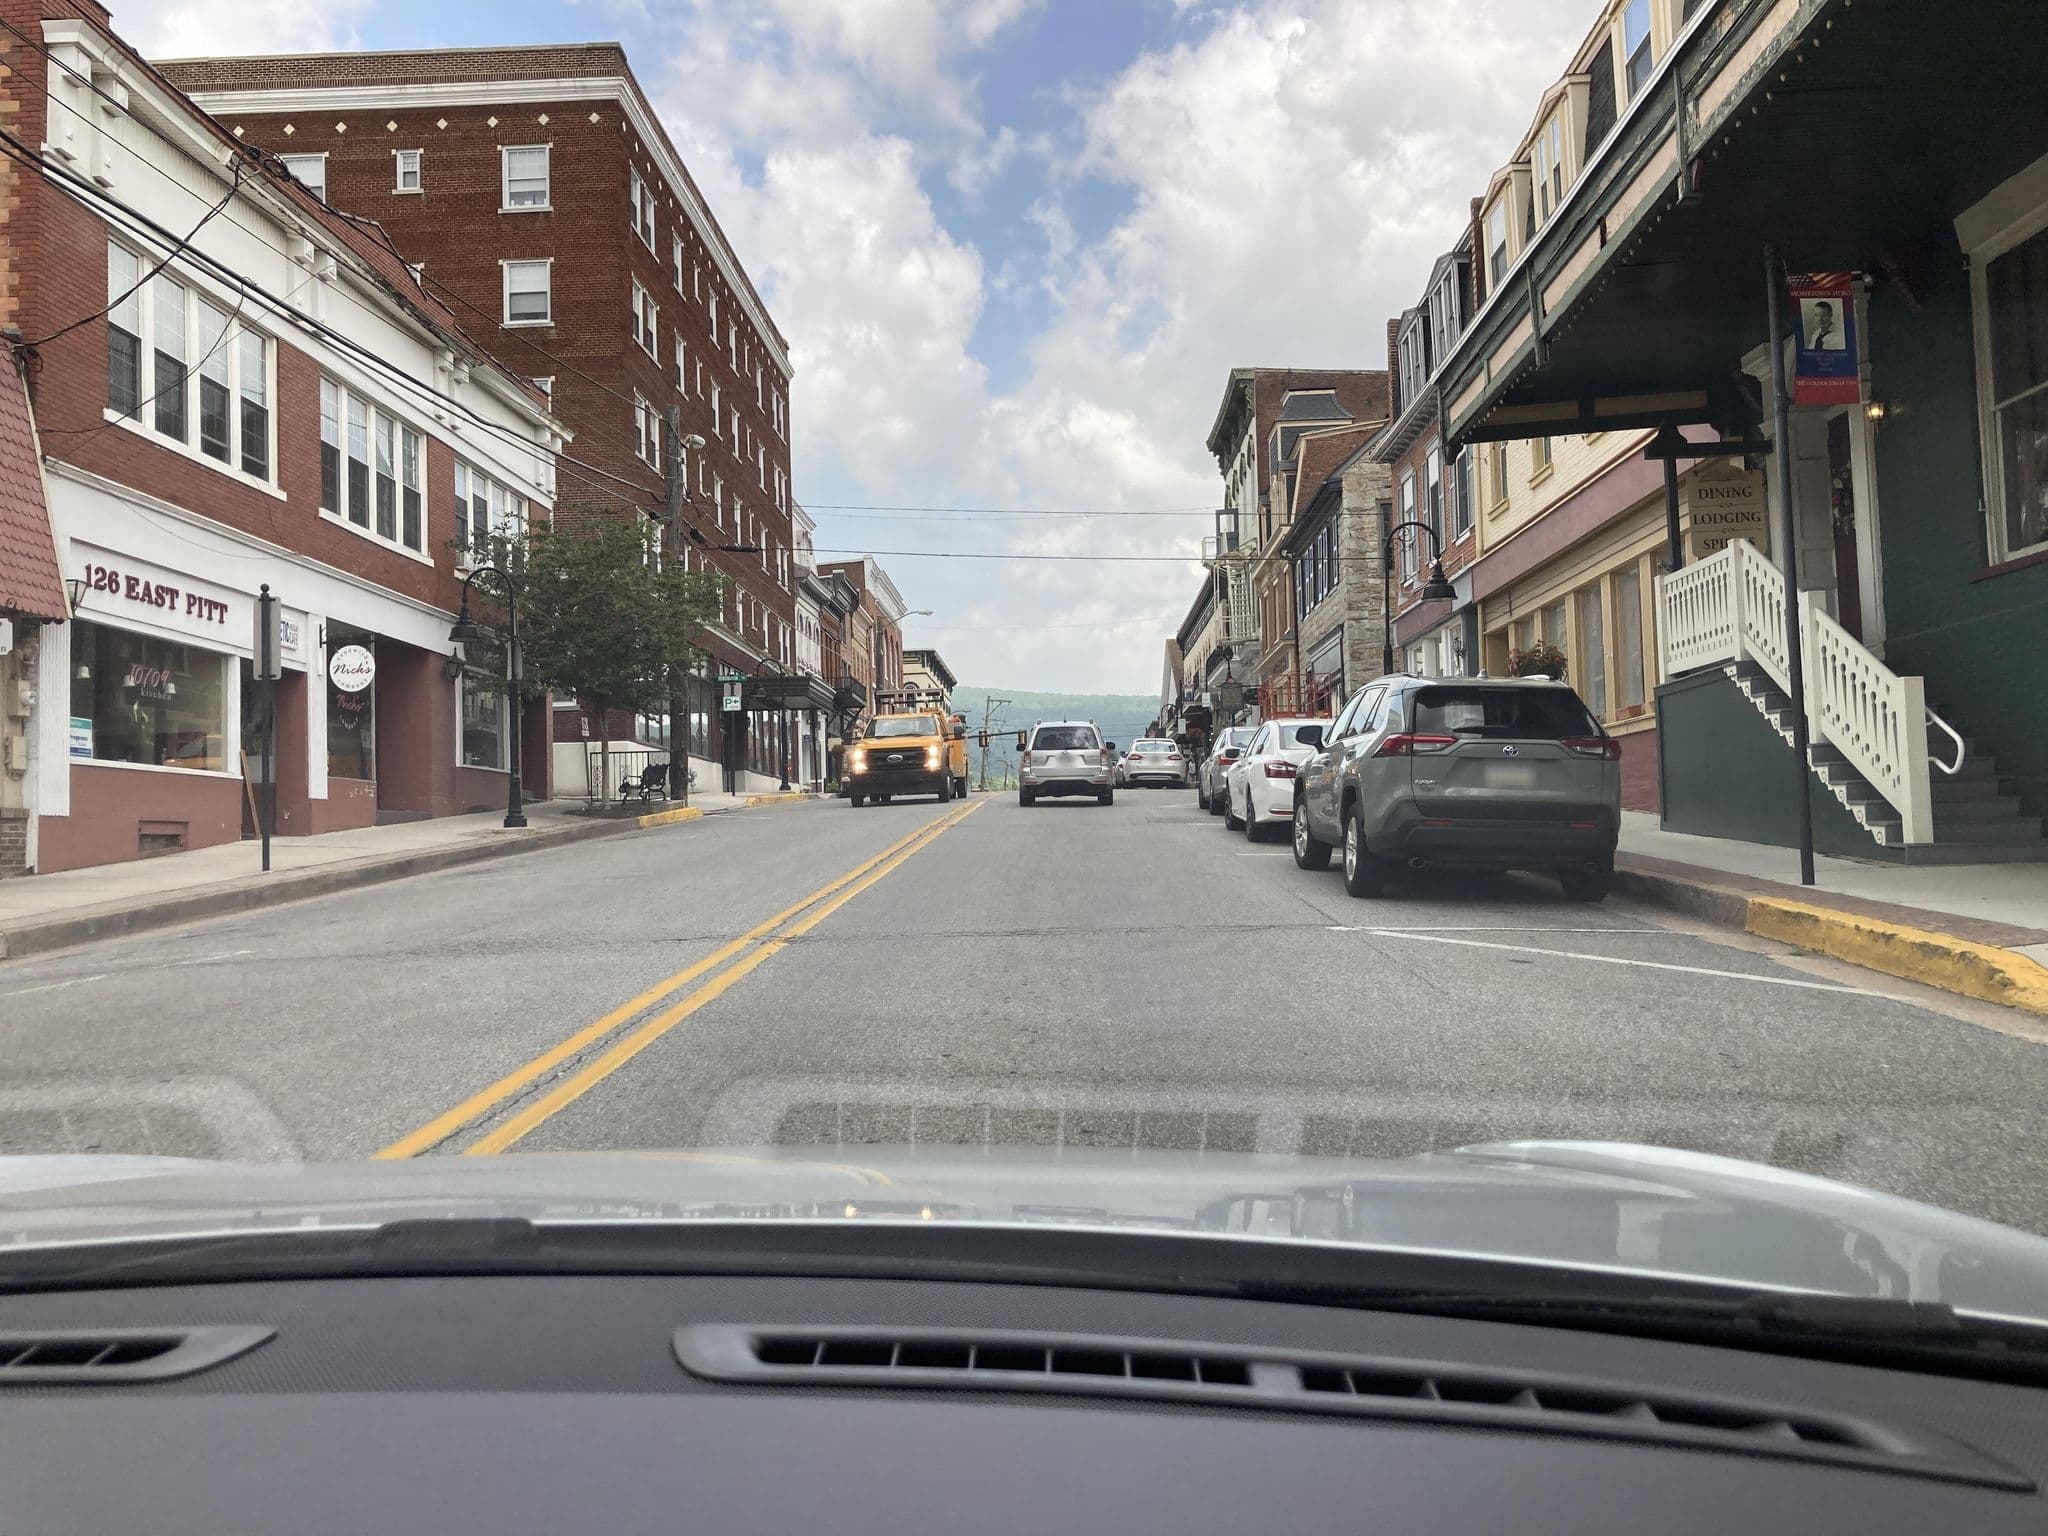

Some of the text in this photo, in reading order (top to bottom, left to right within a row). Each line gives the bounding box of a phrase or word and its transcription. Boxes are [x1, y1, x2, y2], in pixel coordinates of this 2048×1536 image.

[1698, 486, 1752, 499] DINING
[1693, 511, 1761, 525] LODGING
[1703, 536, 1756, 550] SPIS
[85, 563, 228, 624] 126 EAST PITT
[332, 661, 373, 675] Nick's
[725, 698, 732, 709] P
